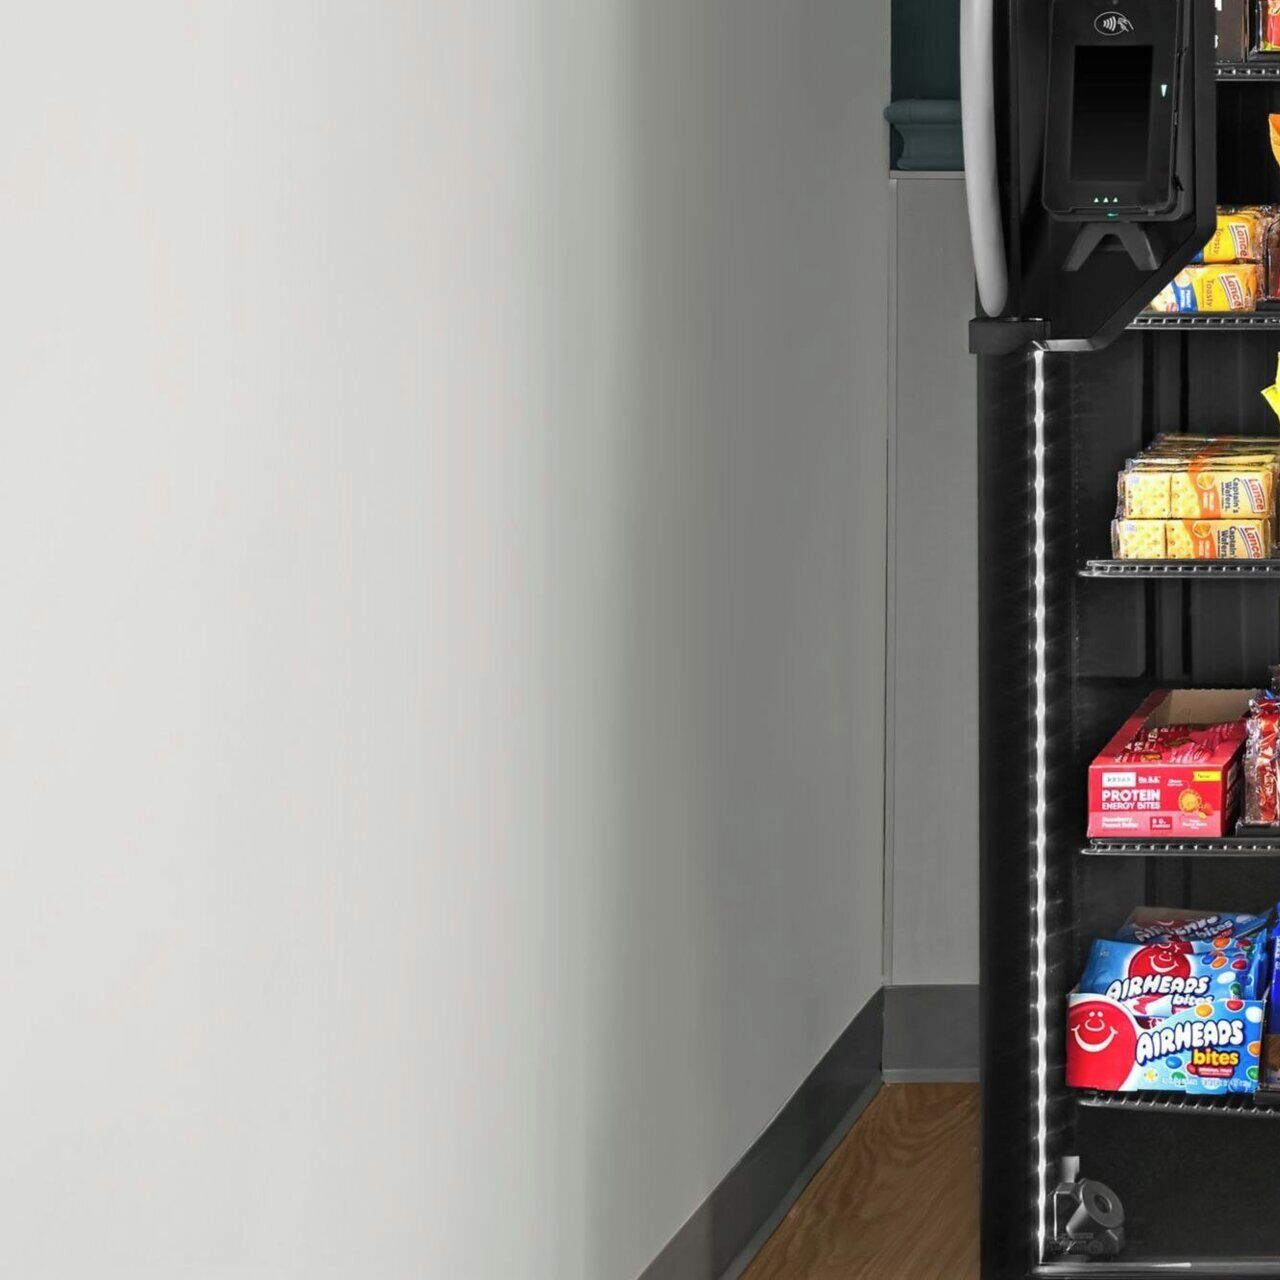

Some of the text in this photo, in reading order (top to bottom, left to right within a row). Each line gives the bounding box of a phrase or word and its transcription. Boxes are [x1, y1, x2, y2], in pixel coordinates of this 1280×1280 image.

[1235, 225, 1248, 257] Lance
[1206, 280, 1214, 308] Toasty
[1225, 275, 1241, 307] Lance
[1232, 477, 1240, 514] Captain's
[1248, 478, 1265, 512] Lance
[1244, 527, 1262, 558] Lance
[1102, 789, 1161, 801] PROTEIN
[1105, 975, 1211, 1002] AIRHEADS
[1136, 1020, 1244, 1065] AIRHEADS
[1193, 1049, 1239, 1066] bites
